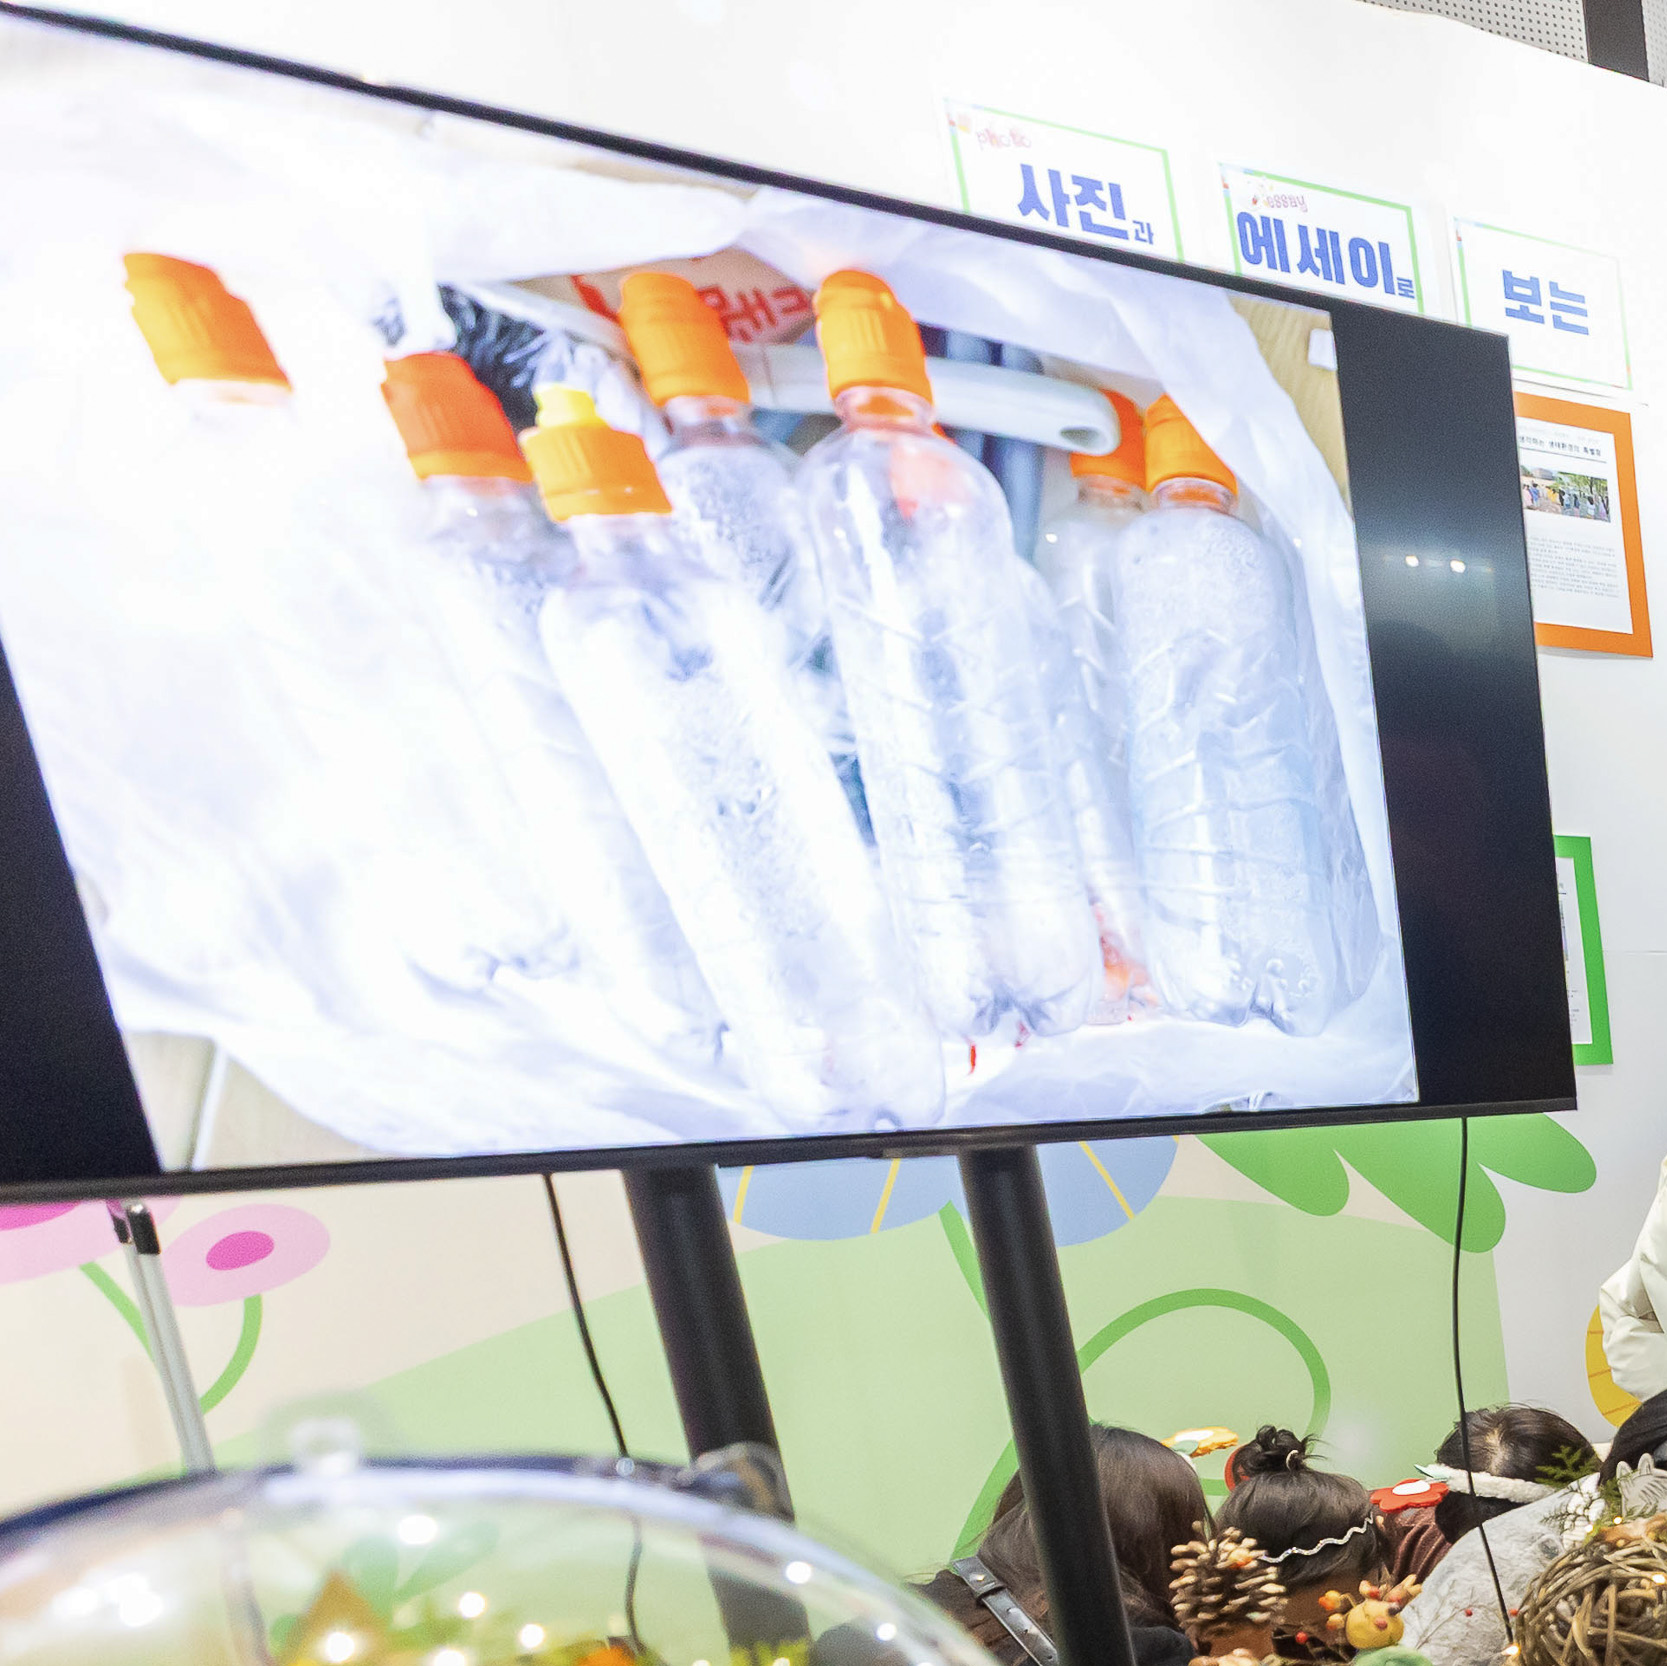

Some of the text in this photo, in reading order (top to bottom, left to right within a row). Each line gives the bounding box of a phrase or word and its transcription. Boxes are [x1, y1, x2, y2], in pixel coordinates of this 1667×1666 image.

[1017, 162, 1590, 336] 사진과 에세이로 보는
[1266, 194, 1308, 213] essay
